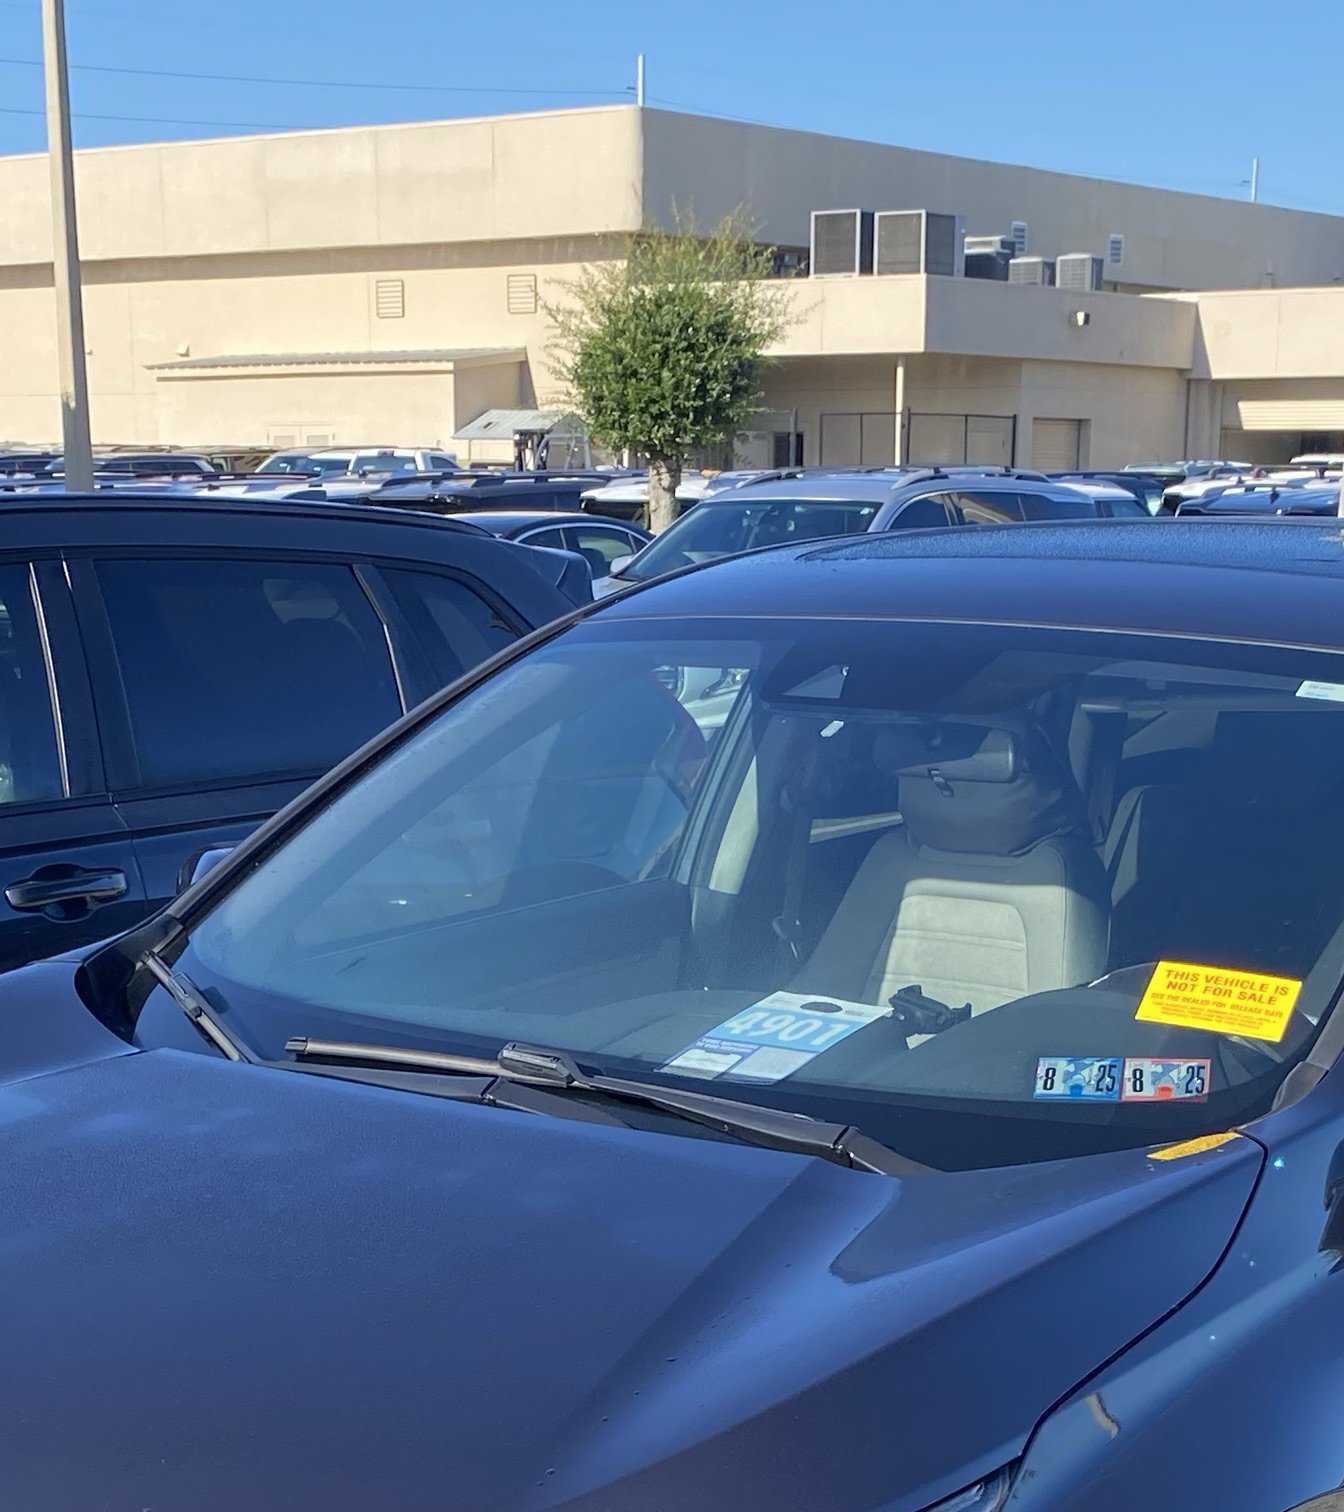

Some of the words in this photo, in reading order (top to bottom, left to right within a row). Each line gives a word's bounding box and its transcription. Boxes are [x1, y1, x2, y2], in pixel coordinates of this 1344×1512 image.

[1165, 969, 1200, 982] THIS
[1204, 974, 1270, 993] VEHICLE
[1274, 985, 1290, 996] IS
[1166, 981, 1199, 993] NOT
[1202, 986, 1233, 999] FOR
[1237, 991, 1278, 1006] SALE
[724, 1011, 850, 1047] 4901
[1042, 1067, 1056, 1091] 8
[1094, 1064, 1118, 1093] 25
[1132, 1068, 1144, 1093] 8
[1184, 1065, 1206, 1094] 25
